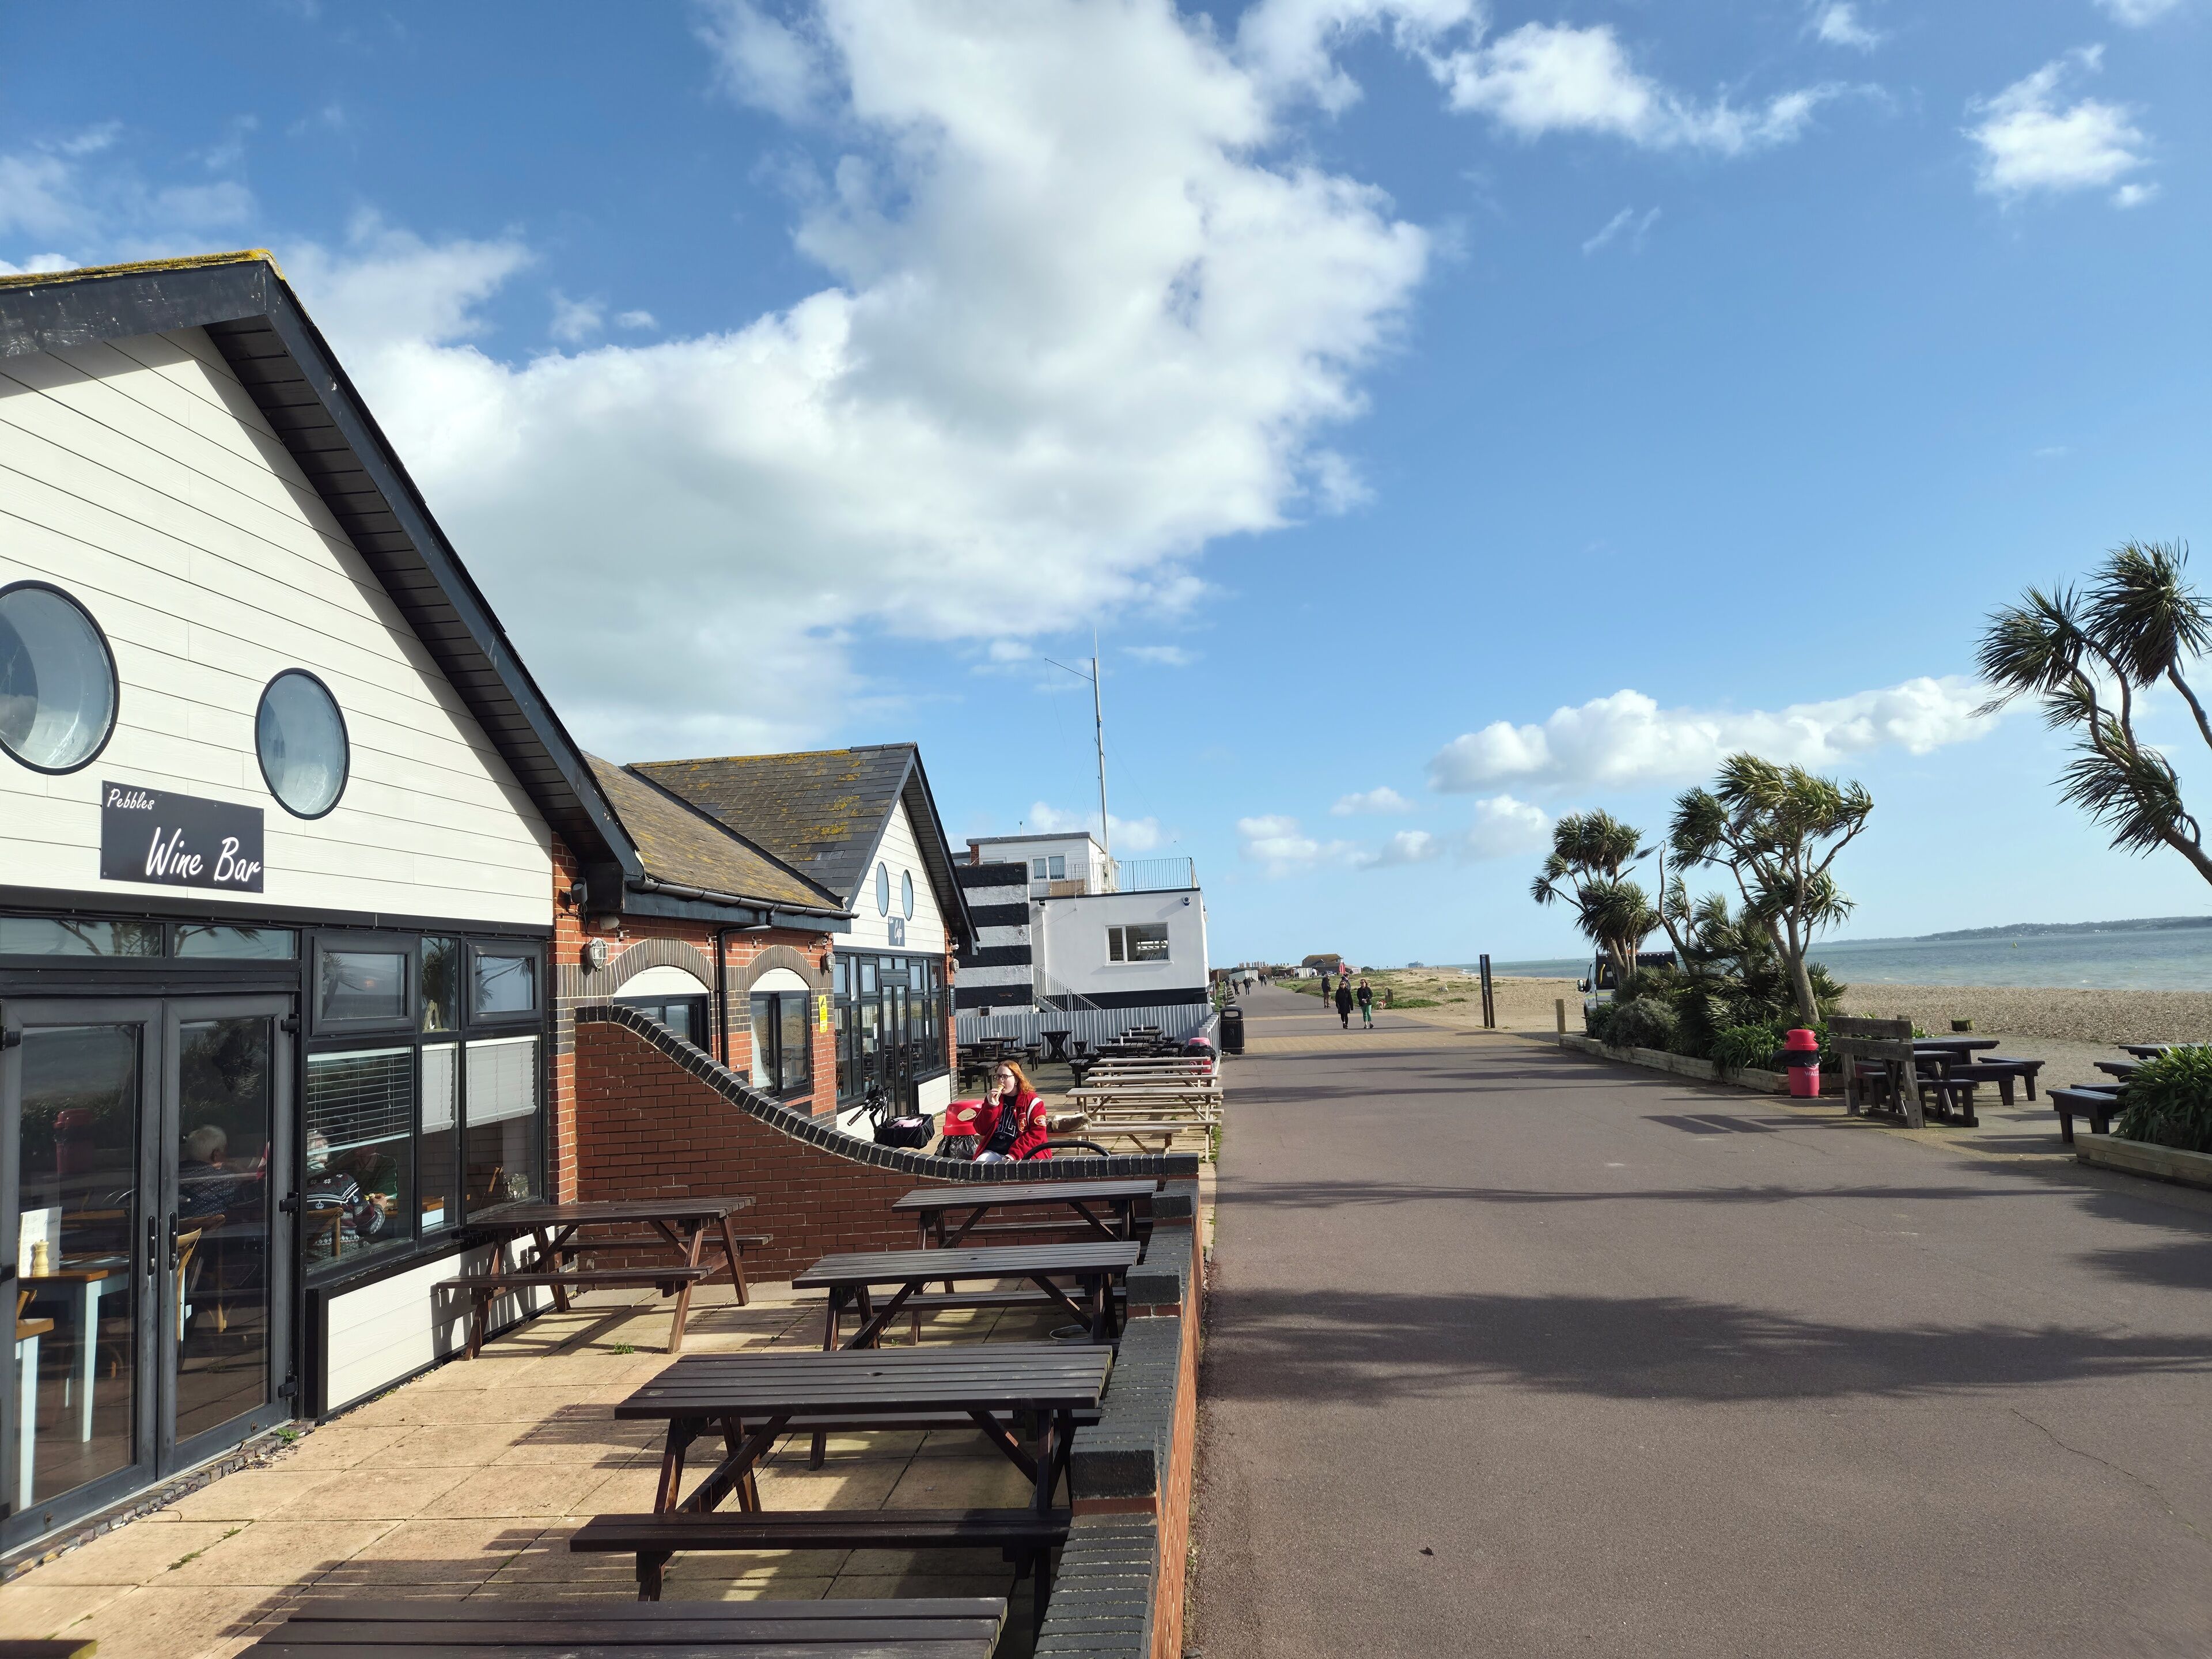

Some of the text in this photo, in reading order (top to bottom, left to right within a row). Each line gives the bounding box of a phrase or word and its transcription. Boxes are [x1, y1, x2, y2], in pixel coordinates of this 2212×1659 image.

[107, 788, 154, 810] Pebbles
[146, 827, 261, 882] Wine Bar
